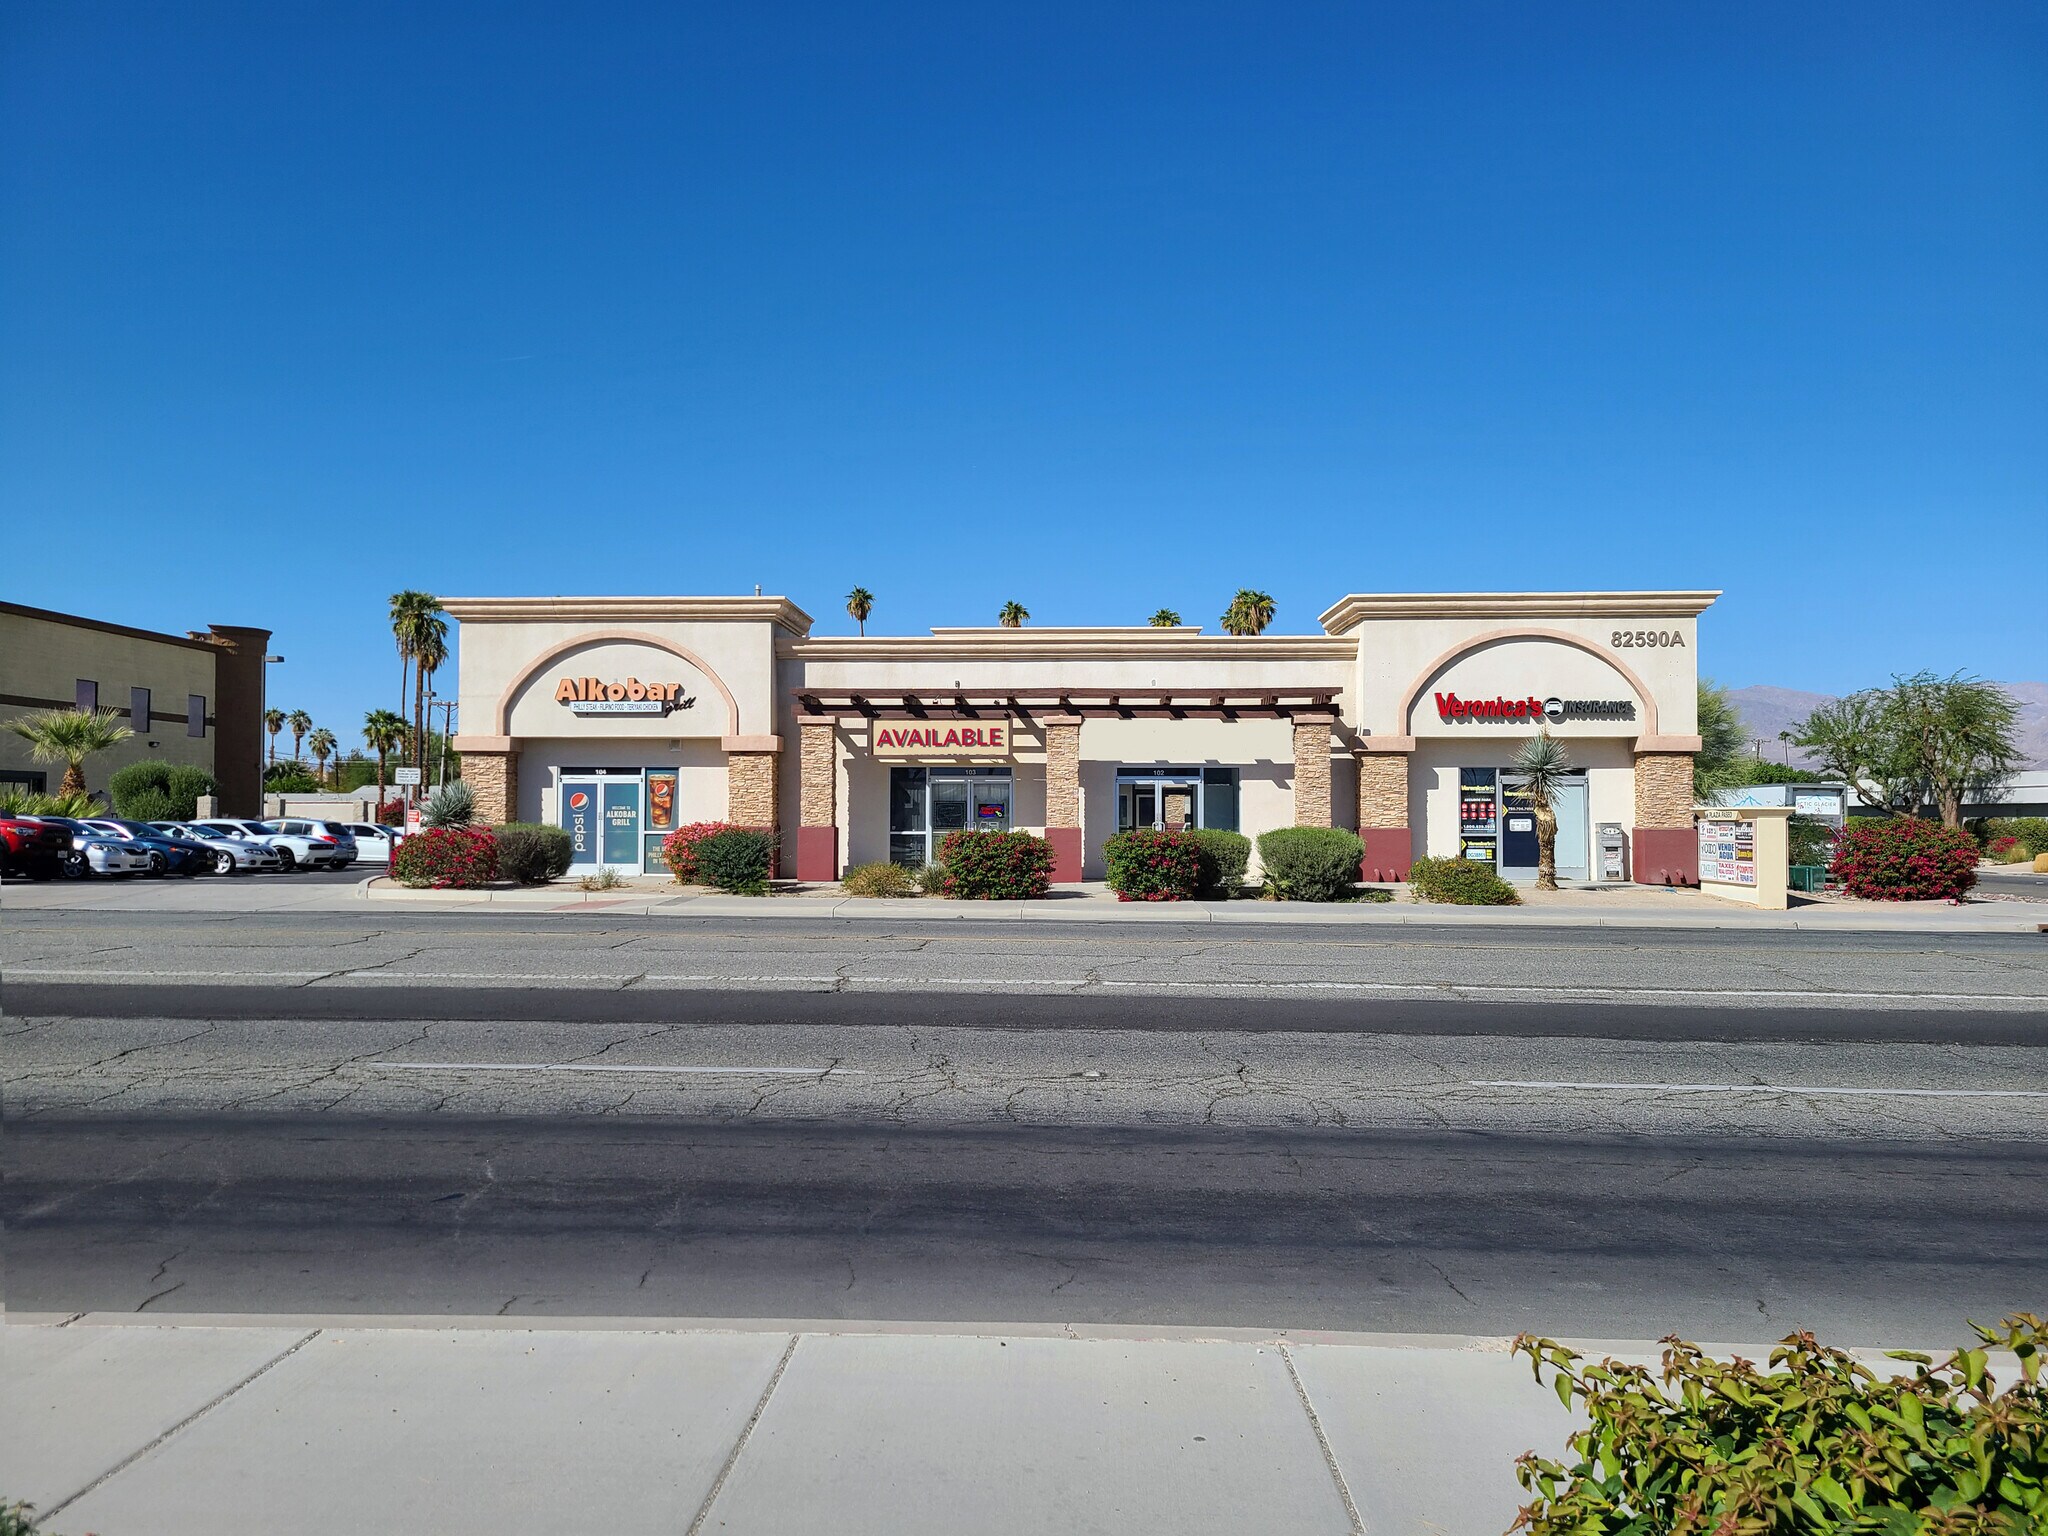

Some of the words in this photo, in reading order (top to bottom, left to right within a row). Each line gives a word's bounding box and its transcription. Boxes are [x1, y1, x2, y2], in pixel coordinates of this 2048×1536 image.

[1610, 631, 1686, 648] 82590A
[554, 678, 681, 701] Alkobar
[573, 703, 585, 711] PHILLY
[586, 703, 598, 711] STEAK
[615, 703, 625, 711] FOOD
[643, 703, 659, 711] CHICKEN
[664, 696, 697, 718] grill
[1434, 692, 1543, 717] Veronica's
[1563, 700, 1634, 715] INSURANCE
[876, 728, 1004, 747] AVAILABLE
[606, 810, 637, 818] ALKOBAR
[612, 818, 631, 826] GRILL
[573, 813, 587, 852] pepsi
[1717, 843, 1735, 852] VENDE
[1718, 851, 1734, 860] AGUA
